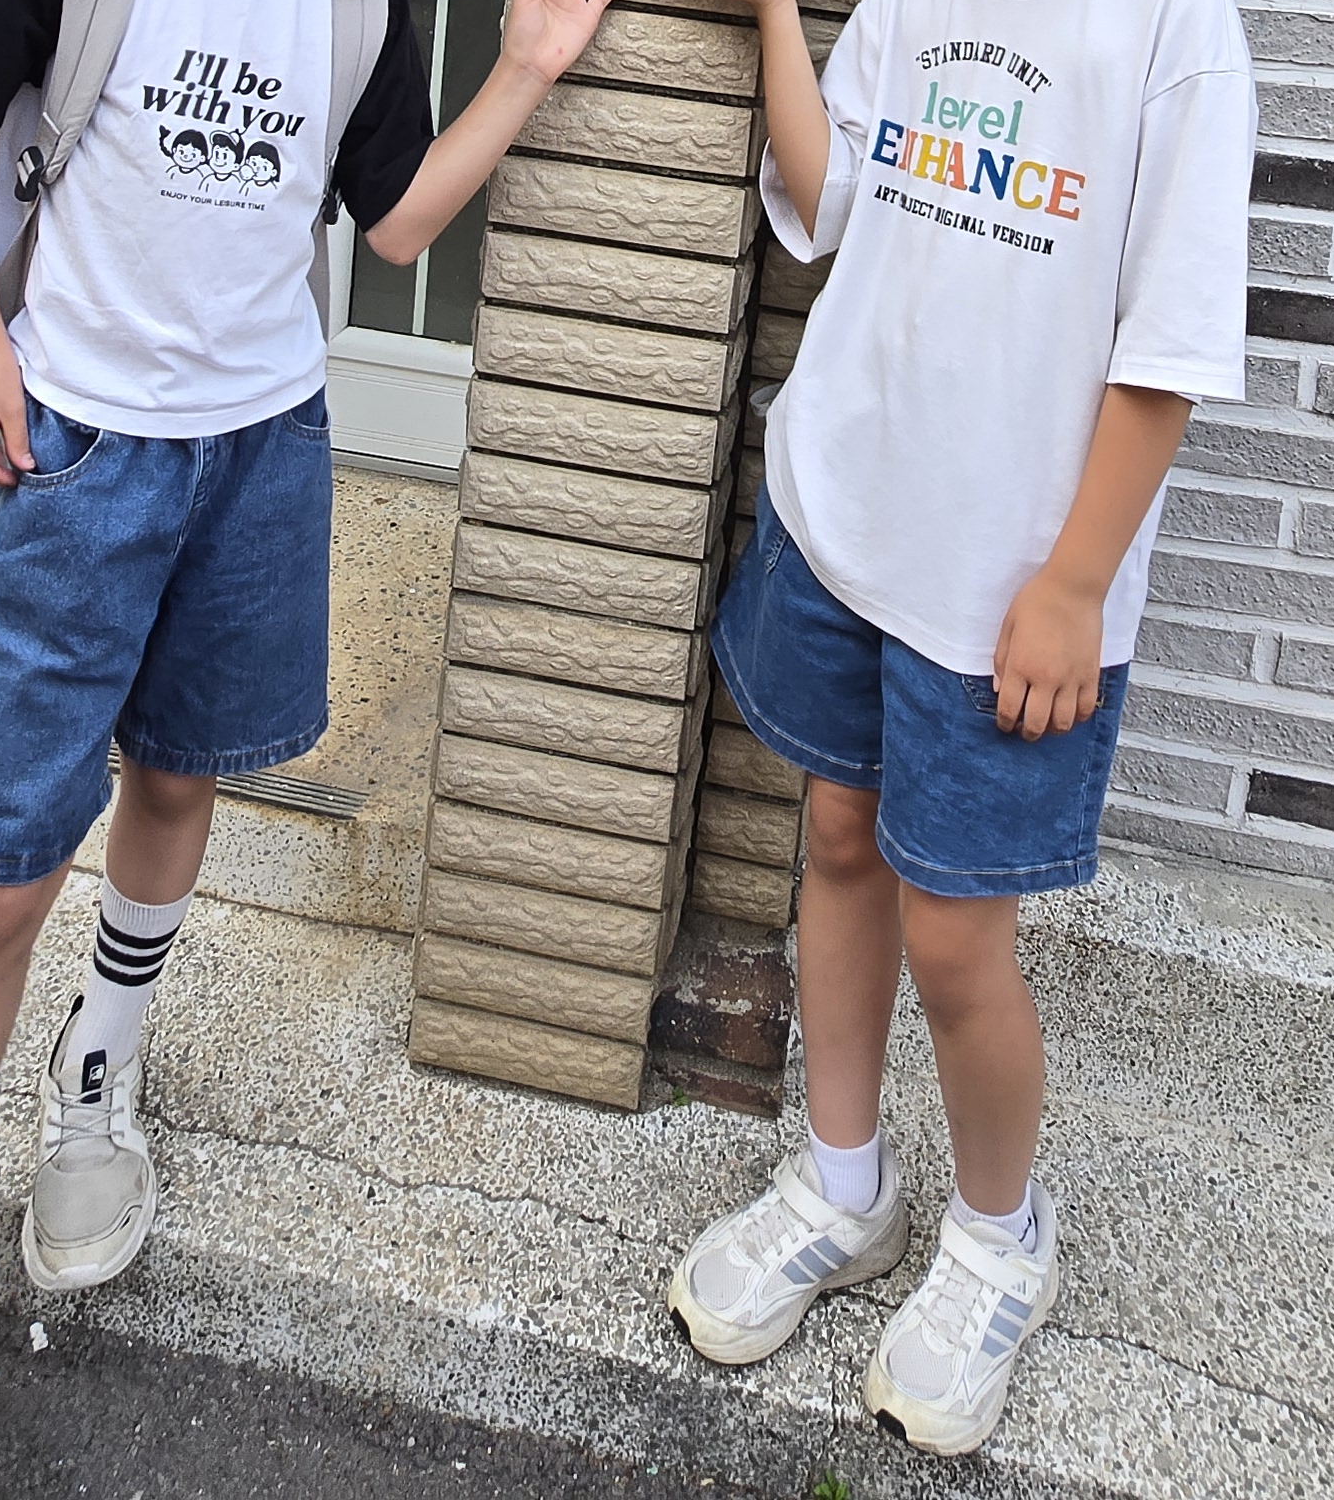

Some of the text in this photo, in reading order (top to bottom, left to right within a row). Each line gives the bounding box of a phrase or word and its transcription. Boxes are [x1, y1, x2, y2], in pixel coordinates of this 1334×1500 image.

[173, 49, 283, 100] I'll be
[142, 82, 305, 137] with you
[921, 81, 1023, 145] level
[160, 189, 266, 211] ENJOY YOUR LEISURE TIME
[874, 184, 899, 204] ART
[992, 223, 1055, 255] VERSION
